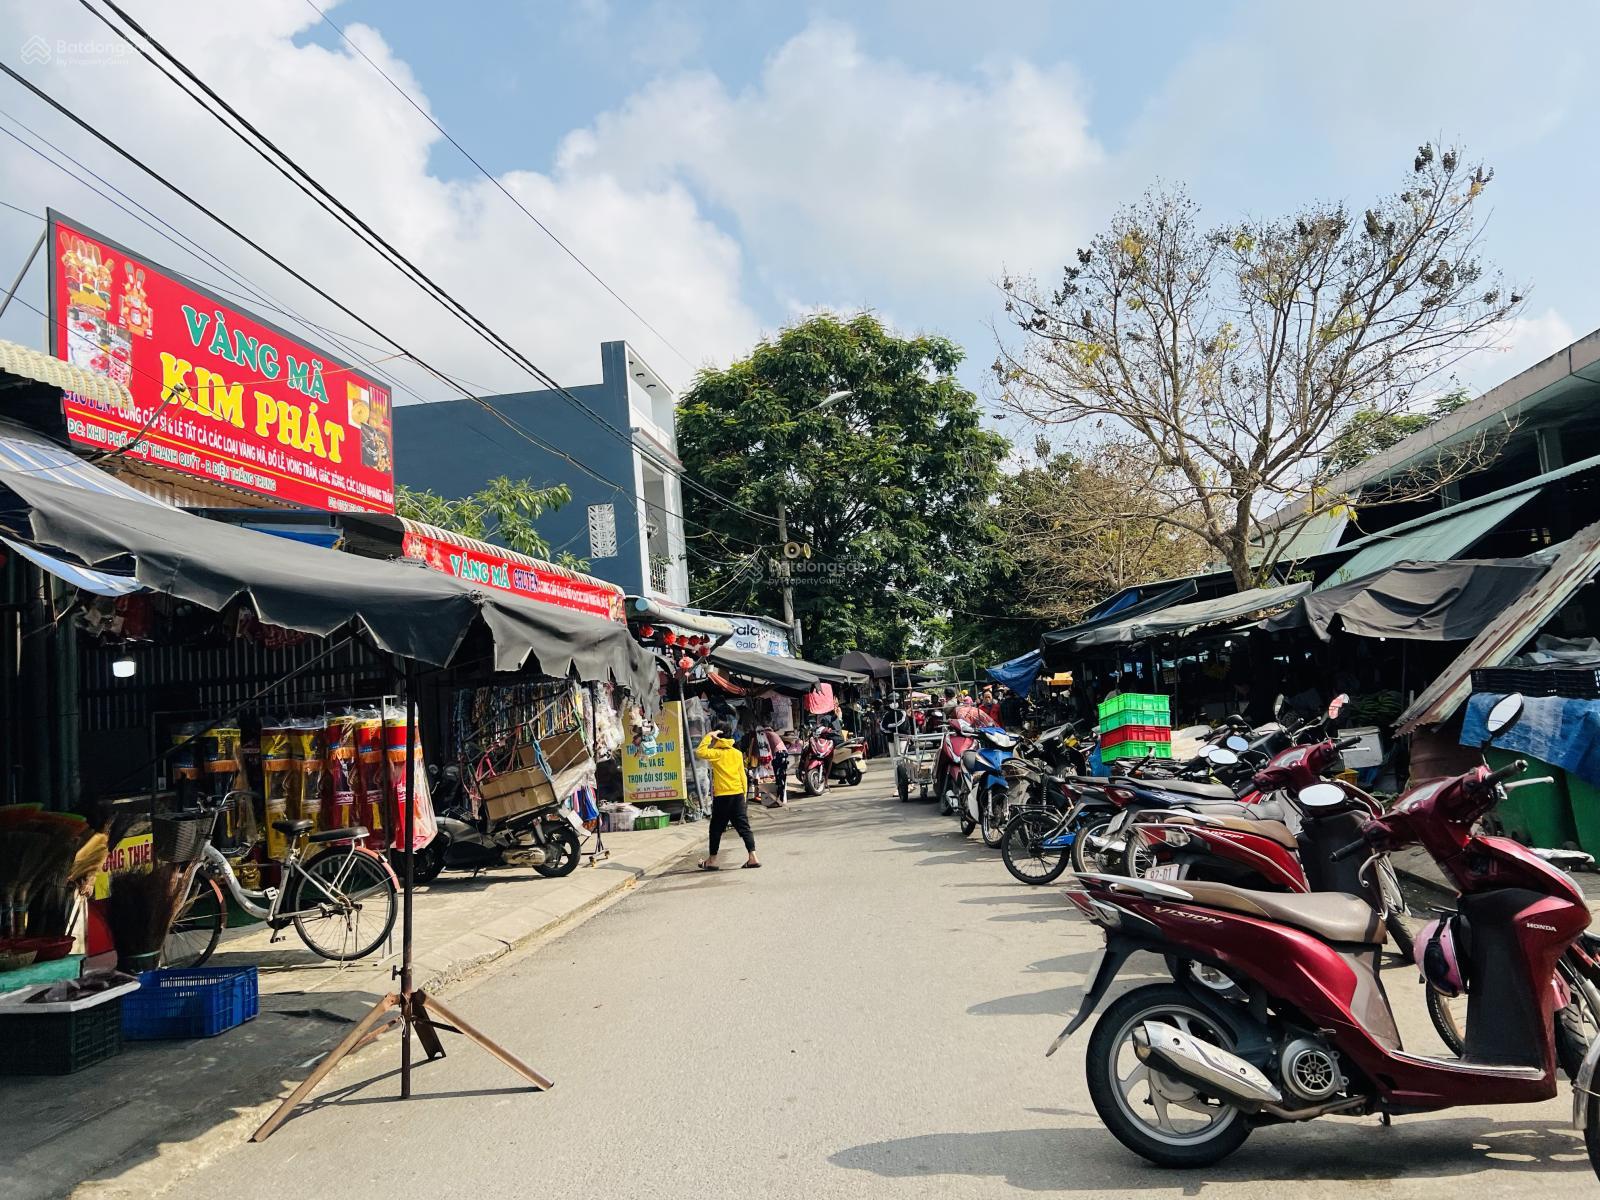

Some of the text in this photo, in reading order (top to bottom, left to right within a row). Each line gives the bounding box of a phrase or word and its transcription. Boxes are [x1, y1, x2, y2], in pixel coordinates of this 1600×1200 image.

[181, 304, 329, 404] VÀNG MÃ
[160, 352, 345, 464] KIM PHÁT
[67, 418, 86, 436] ĐC:
[86, 423, 107, 444] KHU
[107, 429, 129, 449] PHỐ
[150, 442, 178, 464] THANH
[213, 460, 230, 481] ĐIỆN
[254, 475, 276, 491] TRUNG
[184, 420, 197, 441] TẤT
[208, 429, 222, 449] CÁC
[223, 436, 238, 458] LOẠI
[239, 438, 256, 460] VÀNG
[449, 552, 490, 583] VÀNG
[491, 563, 511, 589] MÃ
[664, 771, 678, 781] SINH
[127, 839, 153, 866] THIÊ
[1152, 905, 1224, 925] VISION
[1526, 922, 1557, 932] HONDA
